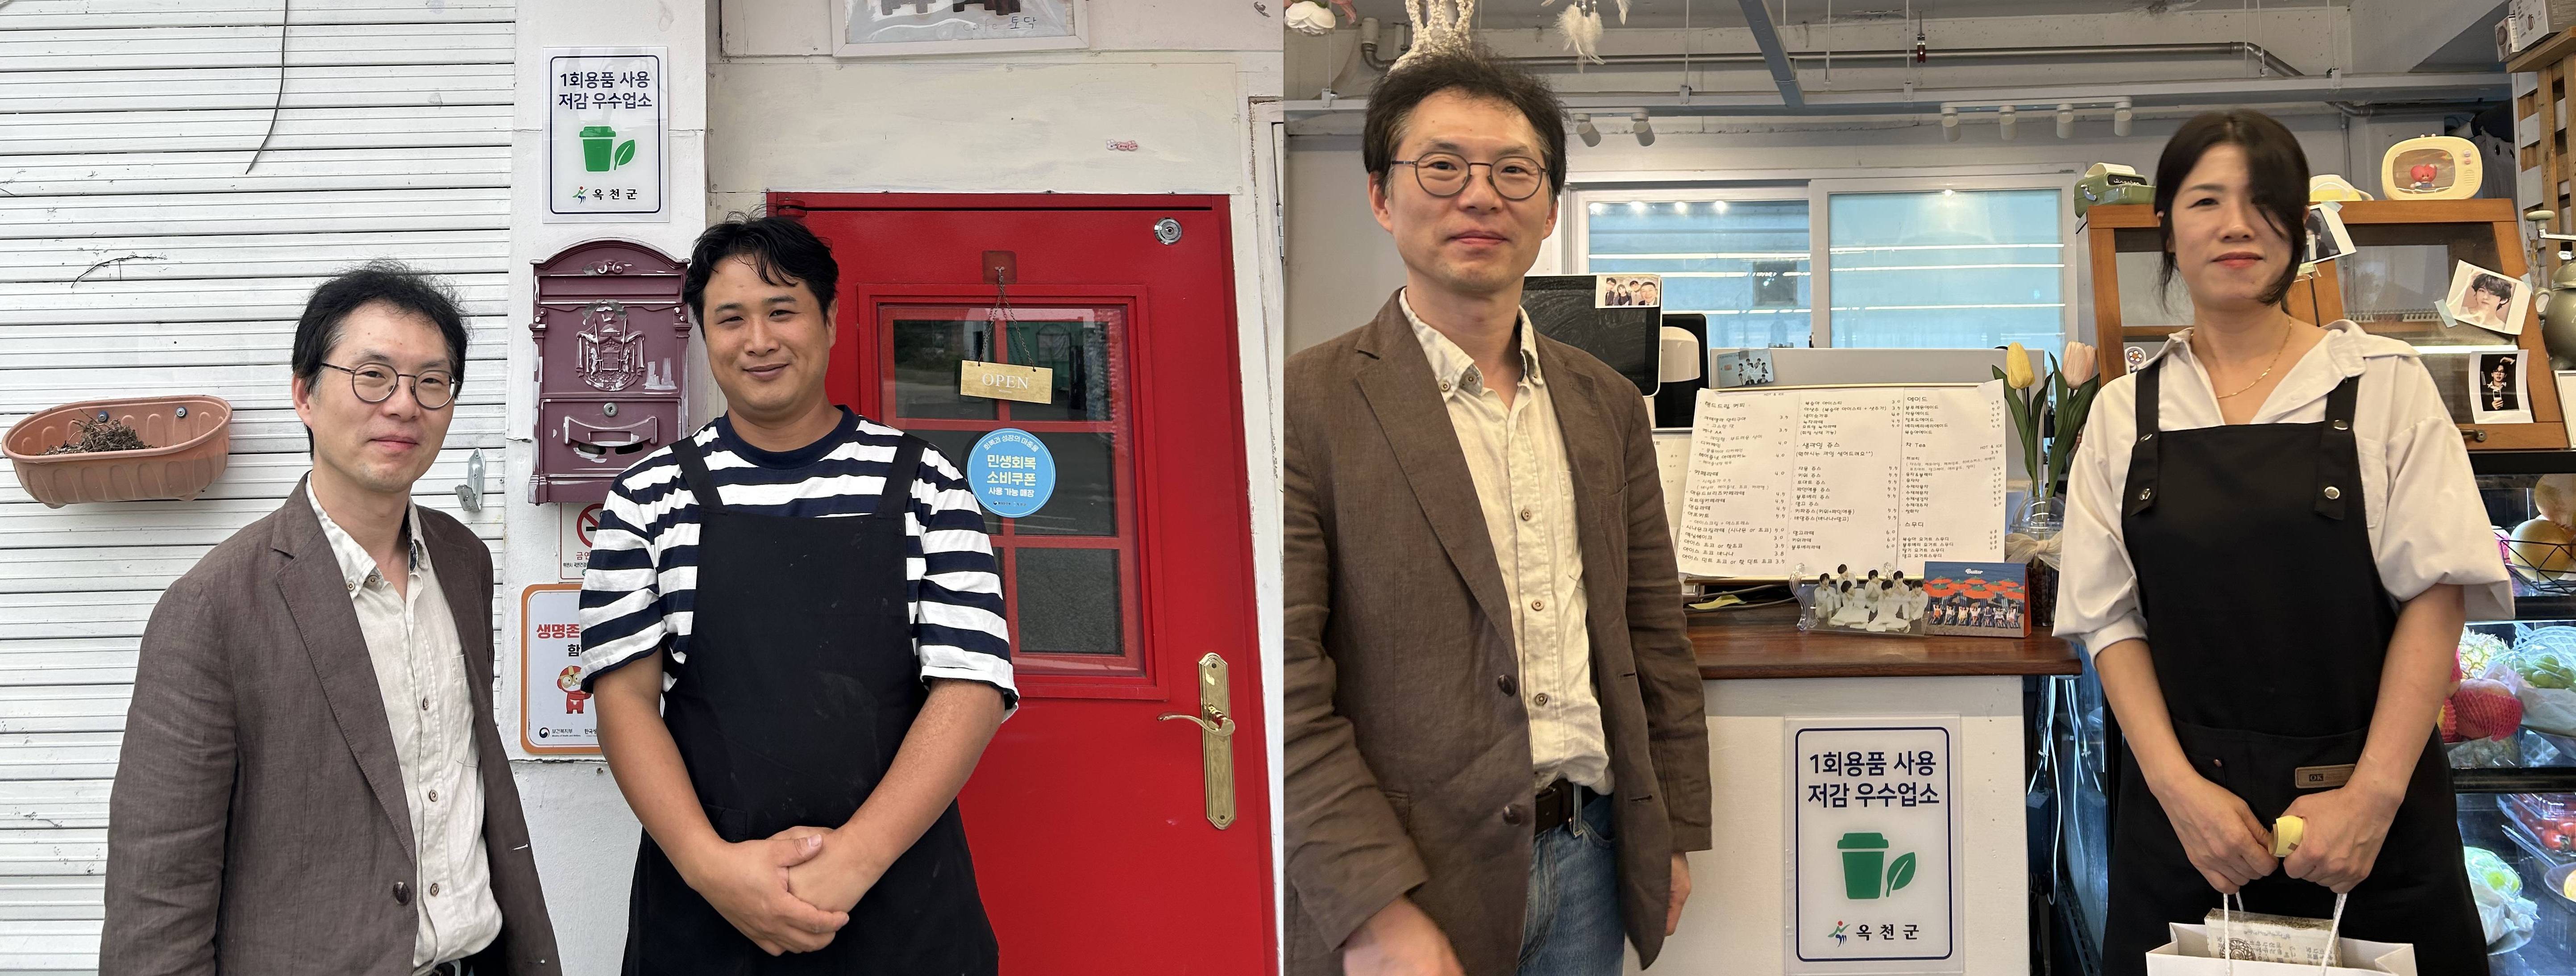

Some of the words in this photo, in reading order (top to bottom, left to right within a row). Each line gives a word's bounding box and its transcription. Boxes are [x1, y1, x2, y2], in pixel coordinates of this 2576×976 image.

[963, 18, 997, 32] cafe
[1010, 16, 1037, 29] 토닥
[560, 72, 615, 88] 1회용품
[619, 71, 650, 88] 사용
[559, 92, 589, 109] 저감
[592, 92, 652, 109] 우수업소
[982, 373, 1028, 389] OPEN
[983, 436, 1001, 450] 회복과
[1021, 438, 1039, 452] 마중물
[987, 454, 1036, 470] 민생회복
[987, 471, 1036, 486] 소비쿠폰
[988, 487, 1002, 495] 사용
[1004, 488, 1018, 496] 가능
[1020, 489, 1035, 497] 매장
[568, 644, 581, 657] 함
[1810, 751, 1886, 776] 1회용품
[1894, 751, 1936, 776] 사용
[1808, 783, 1849, 808] 저감
[1855, 782, 1940, 807] 우수업소
